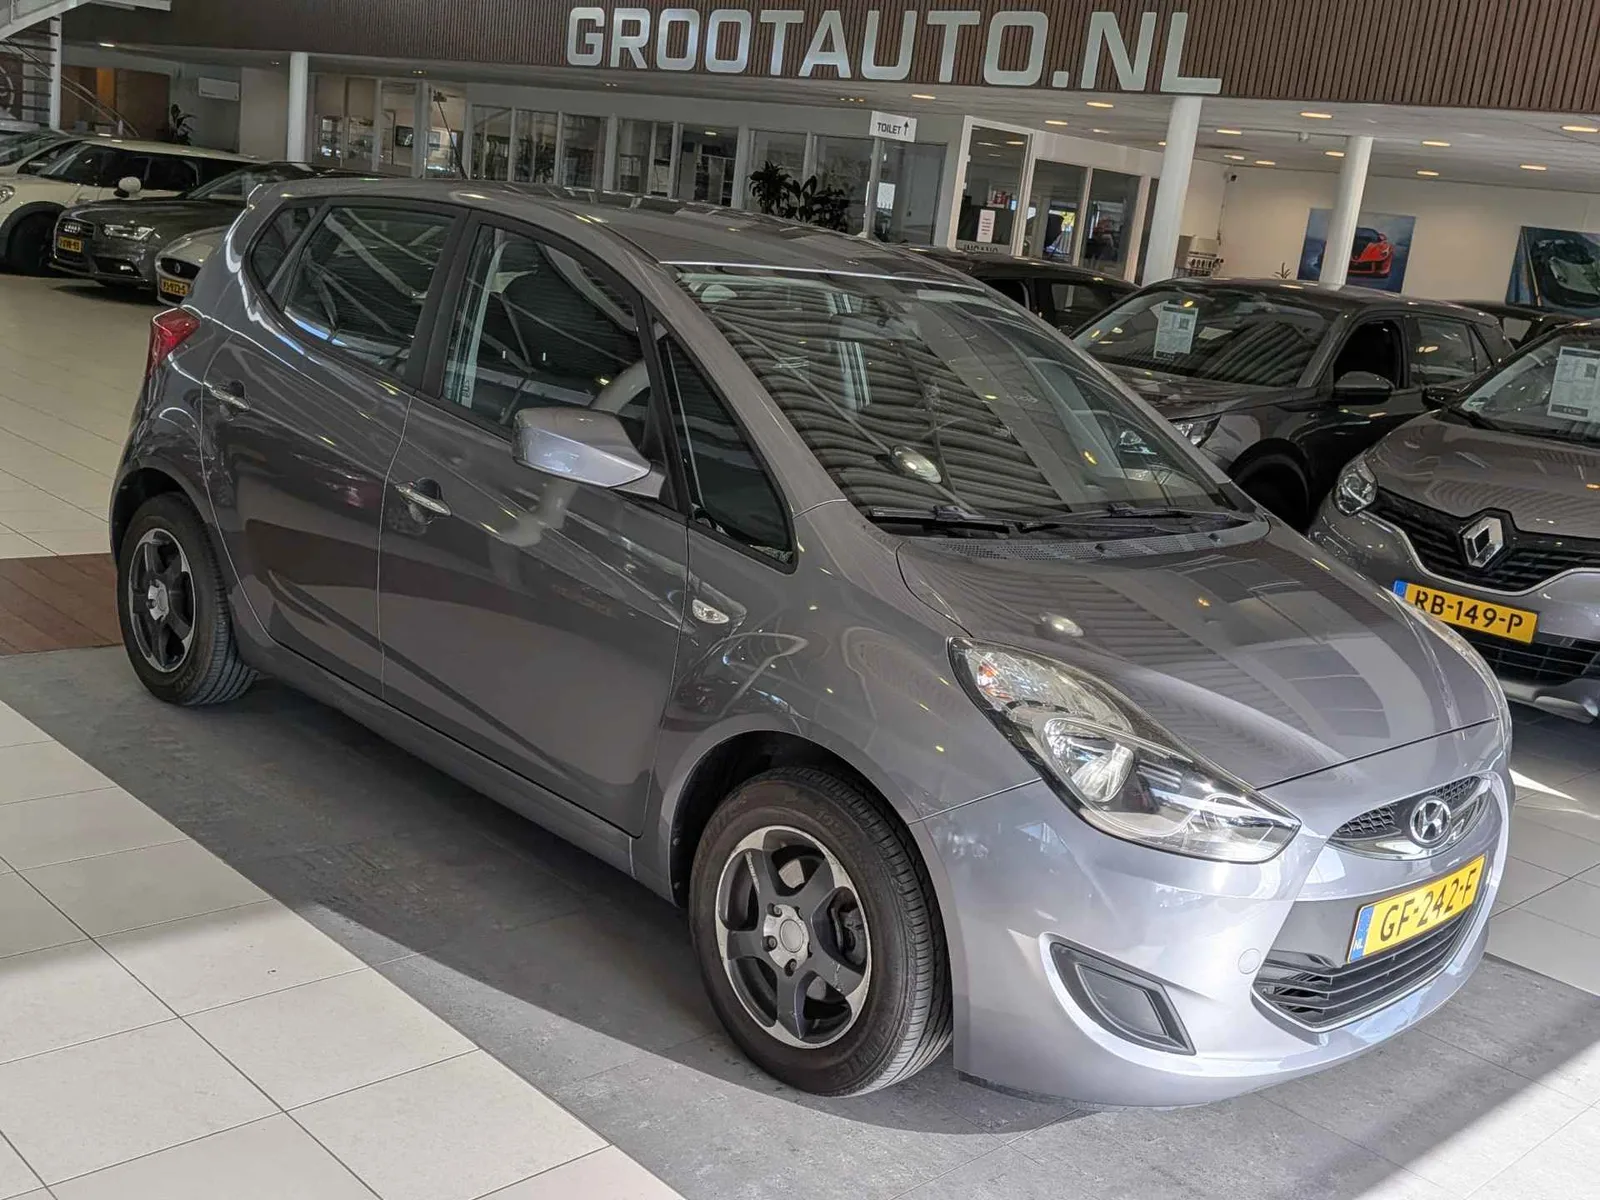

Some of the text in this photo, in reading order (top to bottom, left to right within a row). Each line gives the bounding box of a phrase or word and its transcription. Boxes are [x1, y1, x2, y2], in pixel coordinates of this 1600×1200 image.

[566, 7, 1223, 94] GROOTAUTO.NL
[877, 121, 902, 135] TOILET
[1414, 589, 1524, 634] RB-149-P
[1380, 868, 1477, 942] GF-242-F
[1353, 938, 1364, 951] NL
